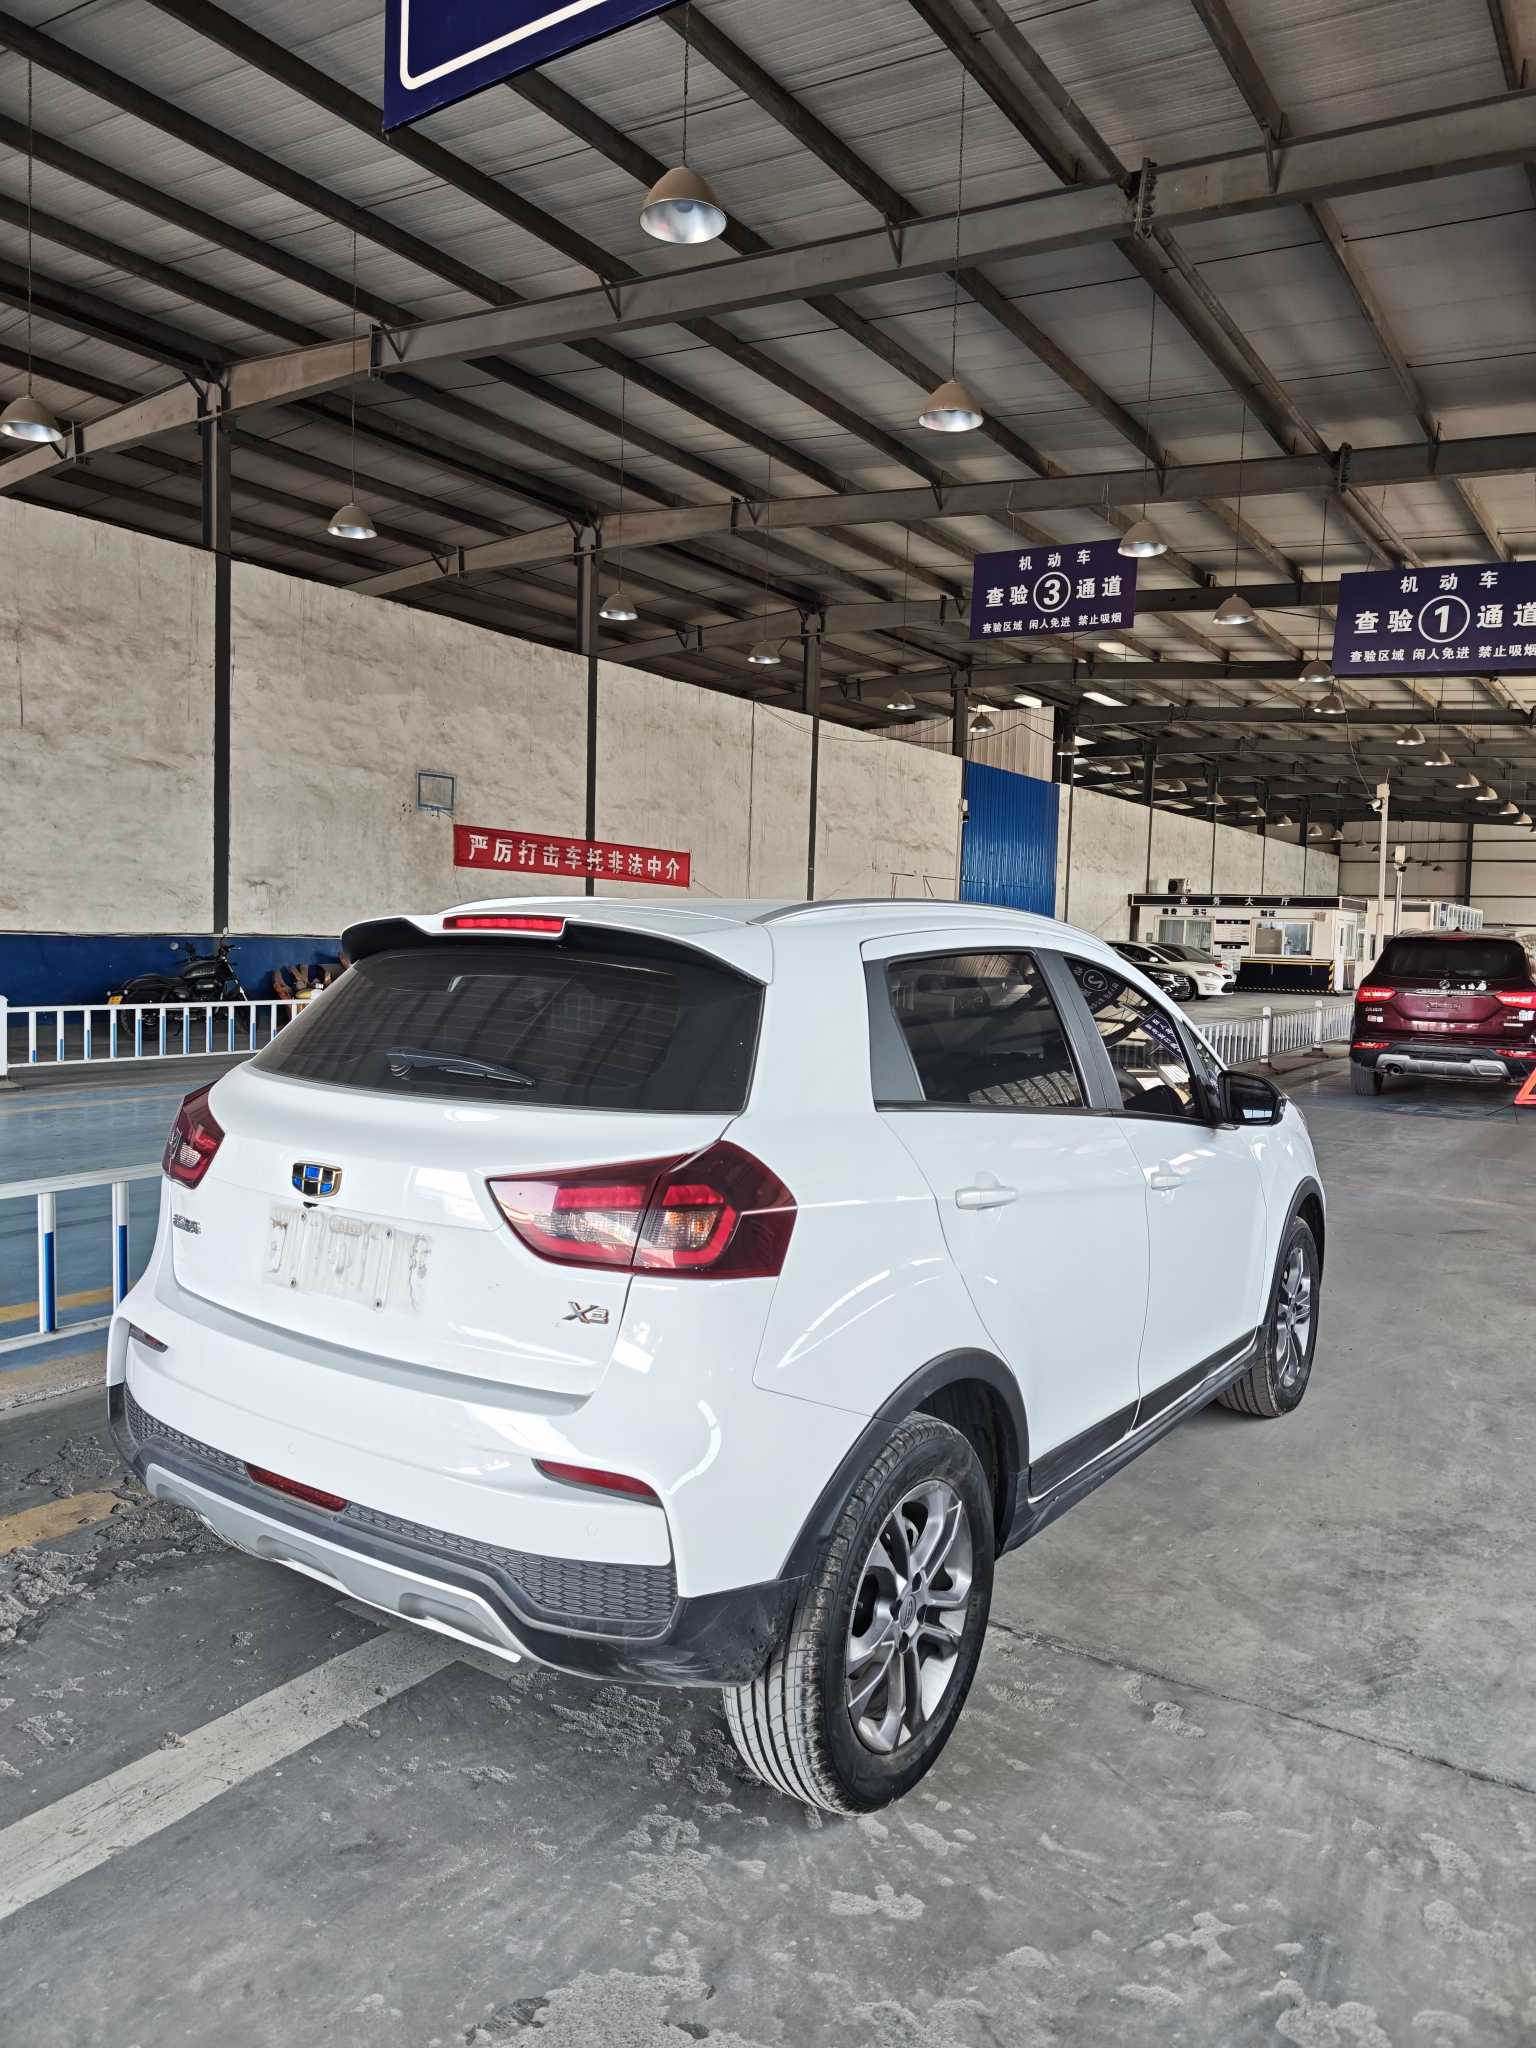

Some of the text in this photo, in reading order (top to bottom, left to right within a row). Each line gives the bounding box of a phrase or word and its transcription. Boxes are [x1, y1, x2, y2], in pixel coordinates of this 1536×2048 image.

[1018, 549, 1091, 571] 机动车
[1400, 571, 1498, 593] 机动车
[981, 612, 1122, 634] 查验区域 闲人免进 禁止吸烟
[1350, 643, 1536, 662] 查验区域 闲人免进 禁止吸烟
[468, 834, 680, 880] 严厉打击车托非法中介
[1180, 897, 1290, 907] 业务大厅
[561, 1301, 609, 1324] X3
